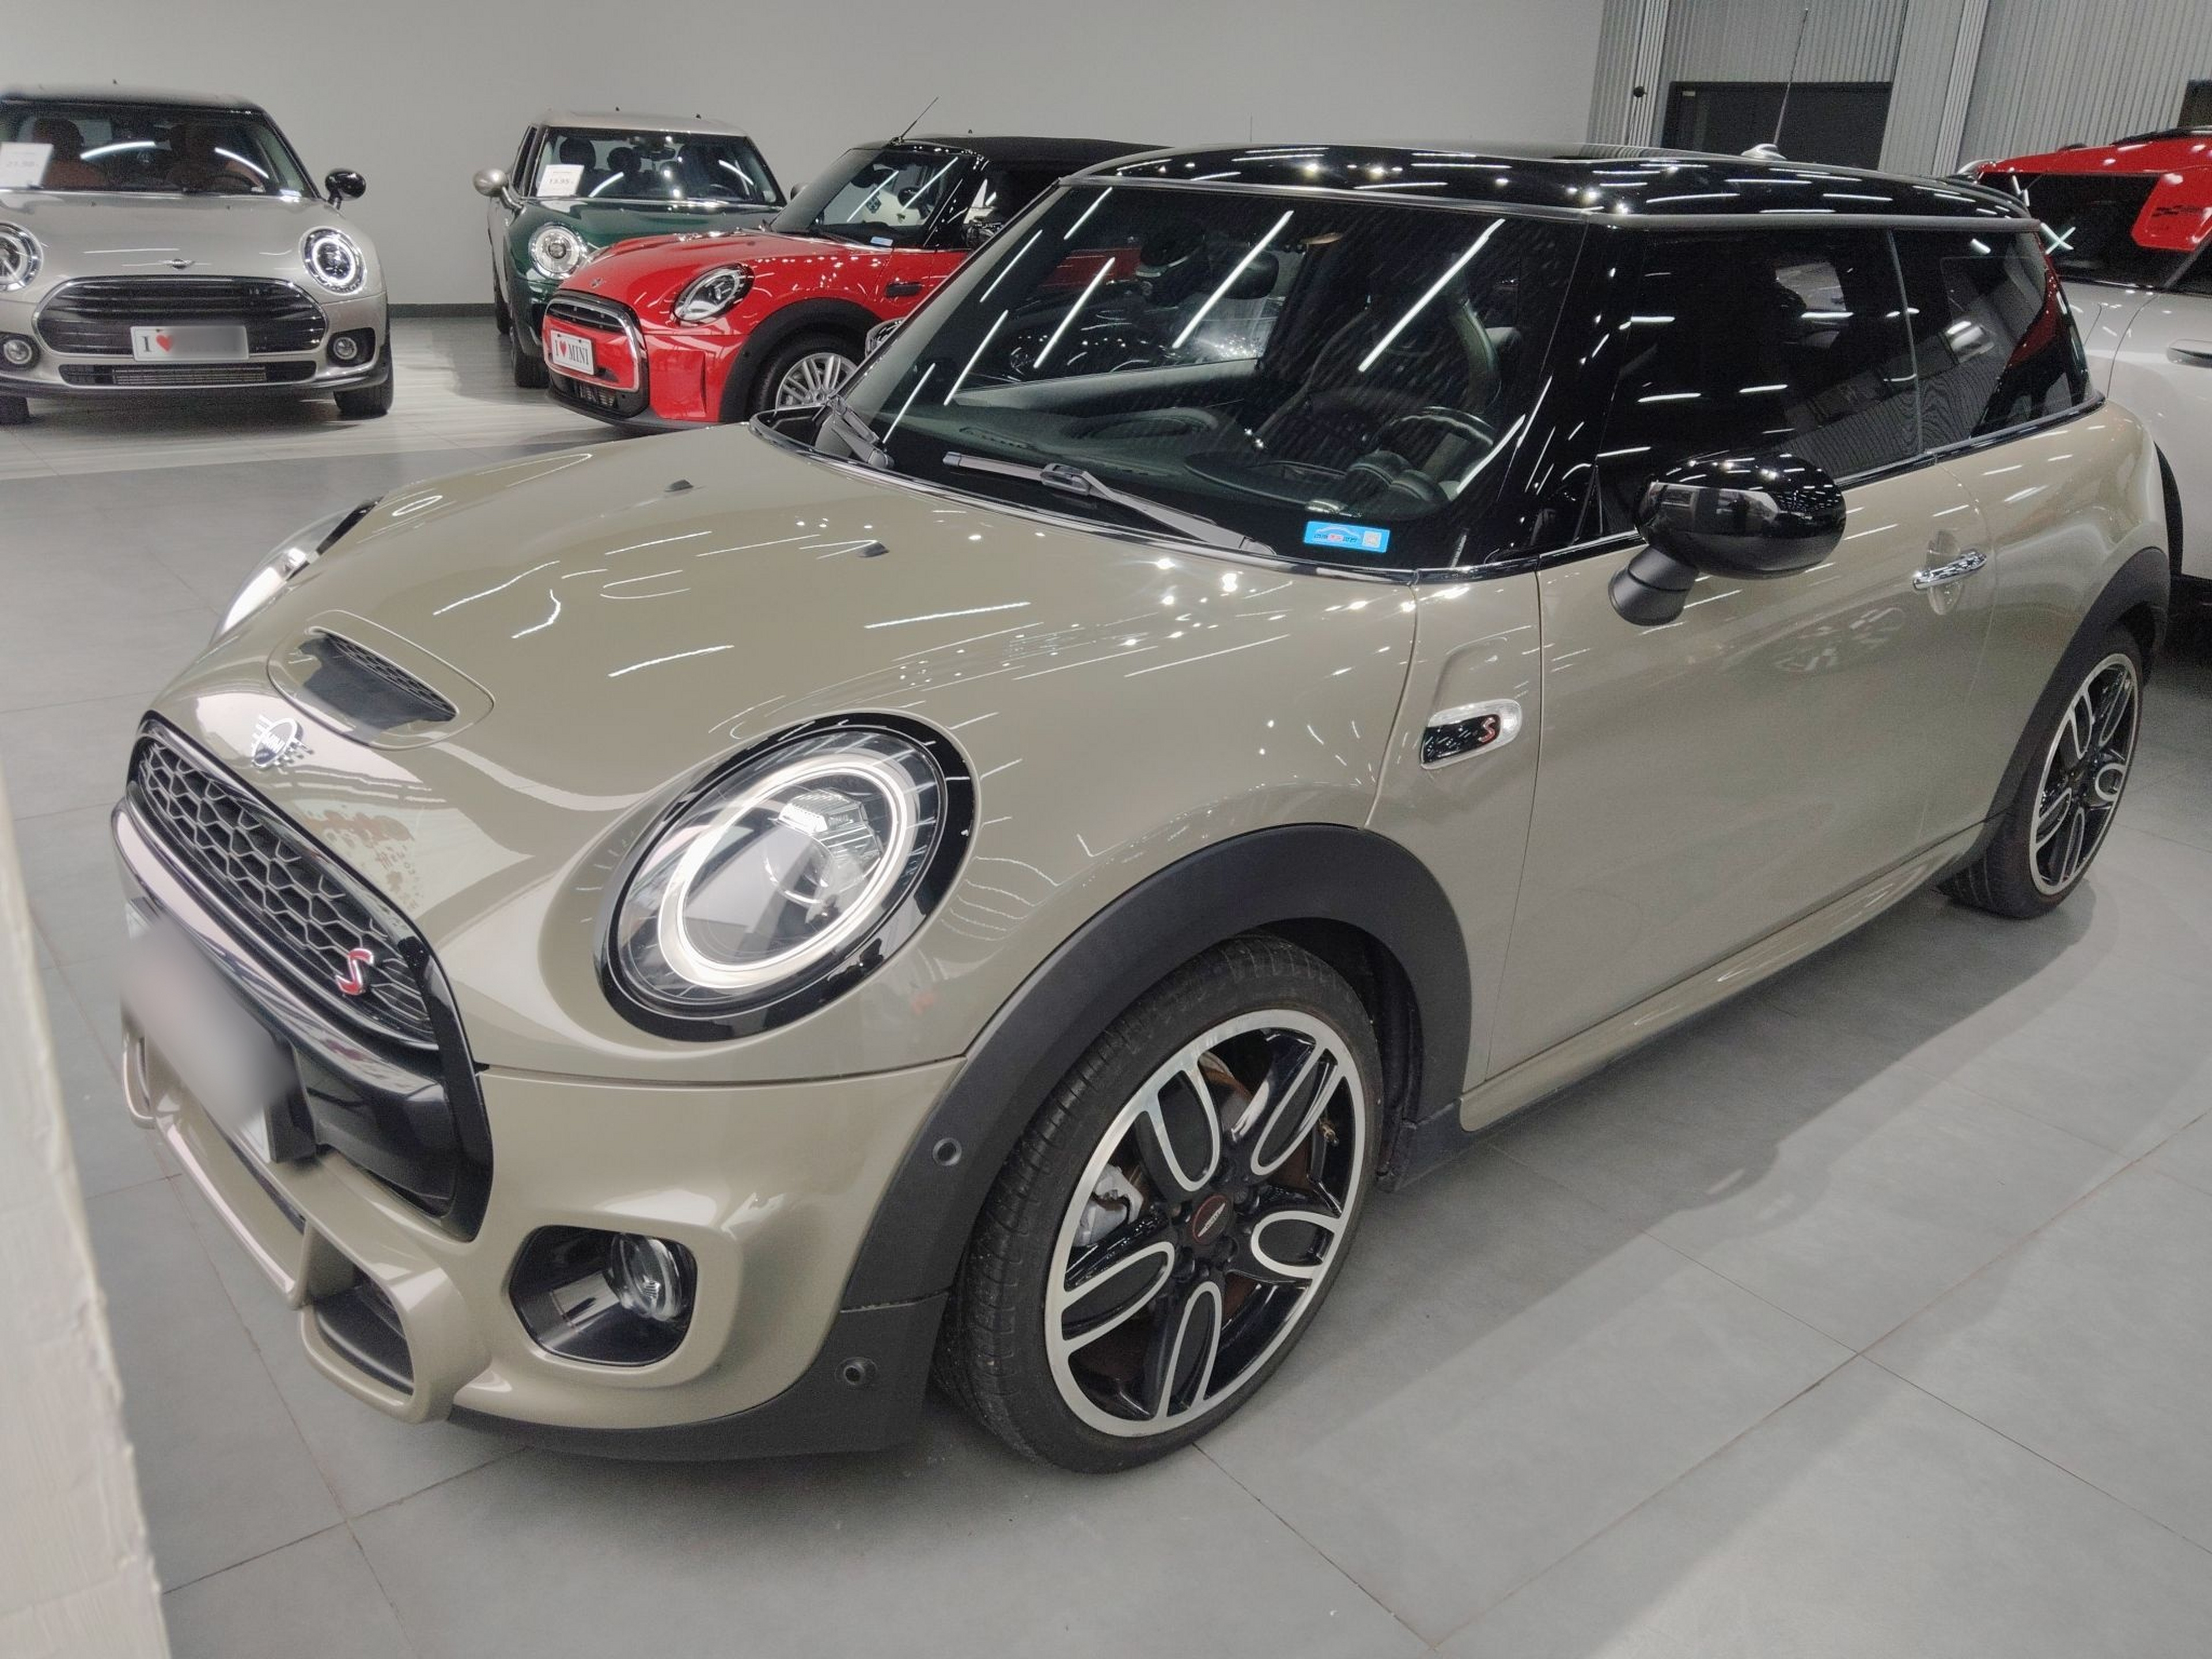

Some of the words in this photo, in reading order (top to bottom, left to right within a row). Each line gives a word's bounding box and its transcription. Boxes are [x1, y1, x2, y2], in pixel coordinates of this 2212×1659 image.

[142, 336, 151, 353] I
[555, 339, 559, 357] I
[568, 343, 589, 365] MINI
[1478, 717, 1496, 743] S
[335, 948, 374, 995] S
